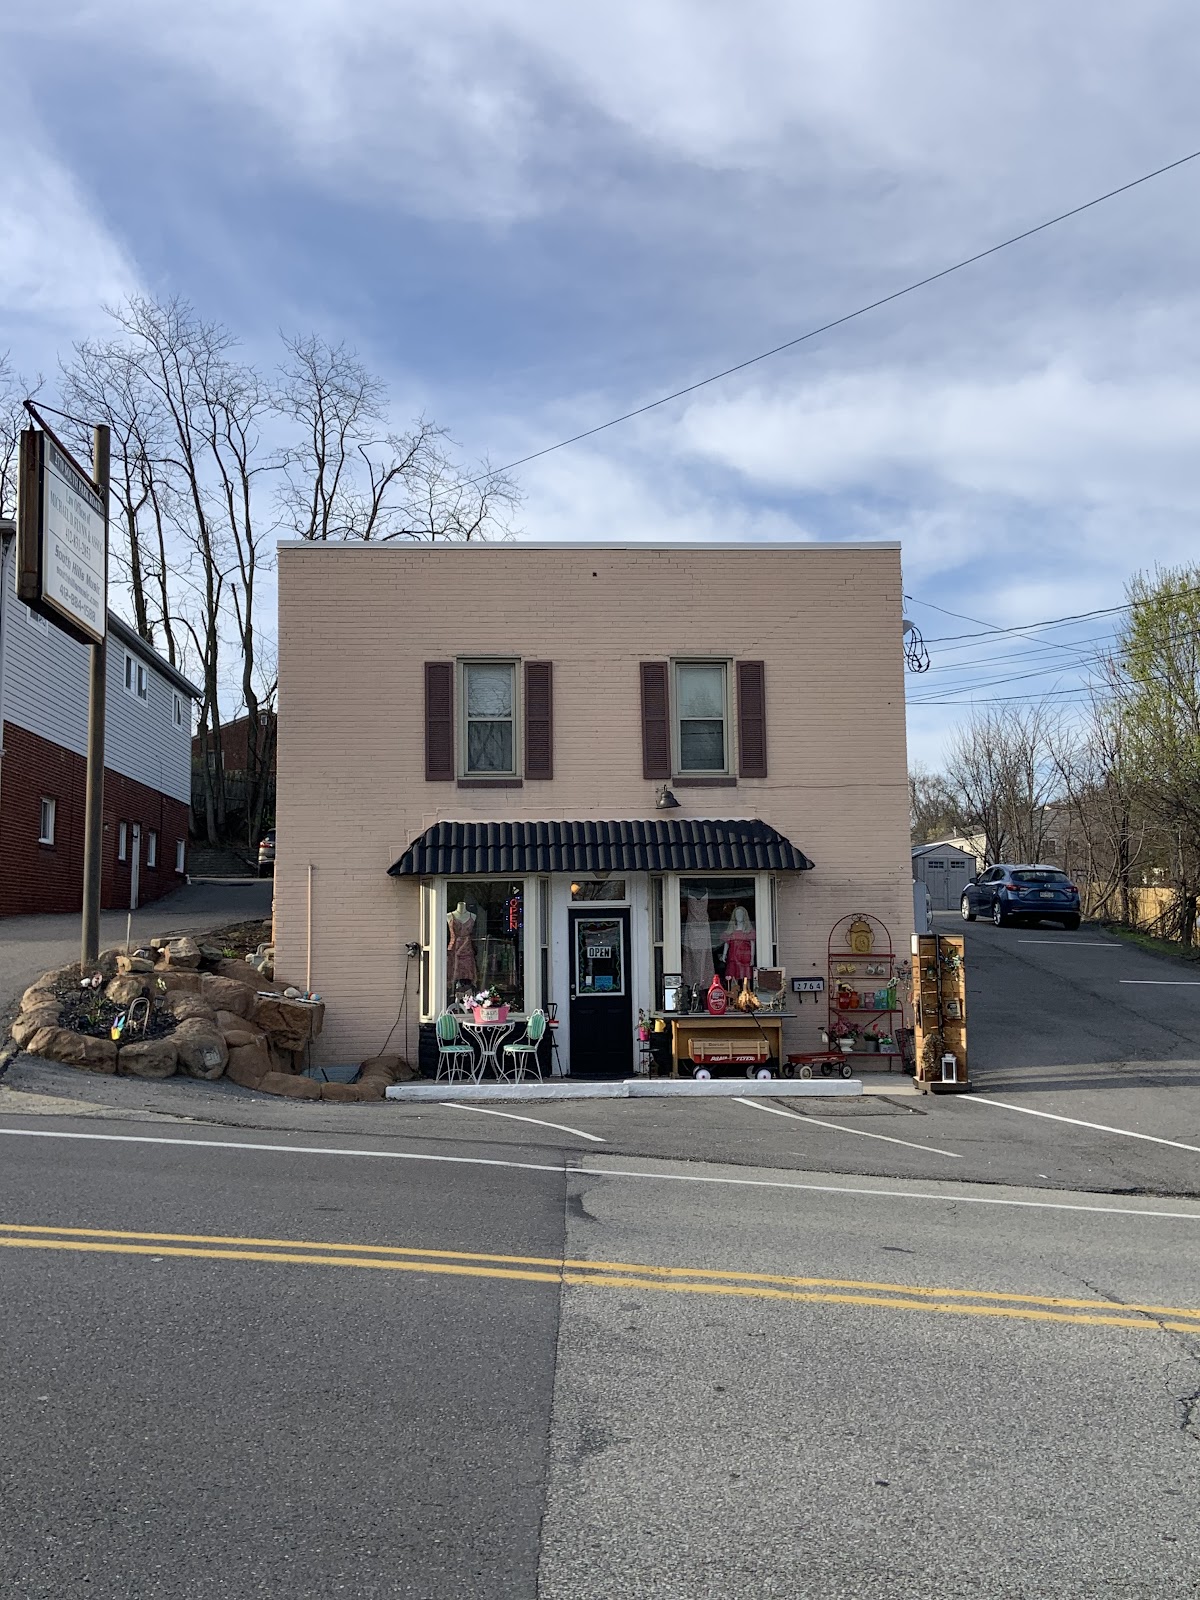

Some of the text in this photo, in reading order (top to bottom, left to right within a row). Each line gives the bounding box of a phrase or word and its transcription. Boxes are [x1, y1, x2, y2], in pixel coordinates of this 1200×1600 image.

[65, 463, 79, 489] SOUTH
[79, 480, 89, 501] PARK
[89, 492, 101, 512] ROAD
[66, 489, 74, 507] Law
[74, 498, 86, 521] Offices
[50, 490, 69, 522] MICHAEL
[74, 516, 87, 538] FLYNN
[54, 544, 101, 595] South Hills Music
[56, 566, 99, 609] southhillsmusic.com
[509, 898, 518, 930] OPEN
[589, 947, 610, 957] OPEN
